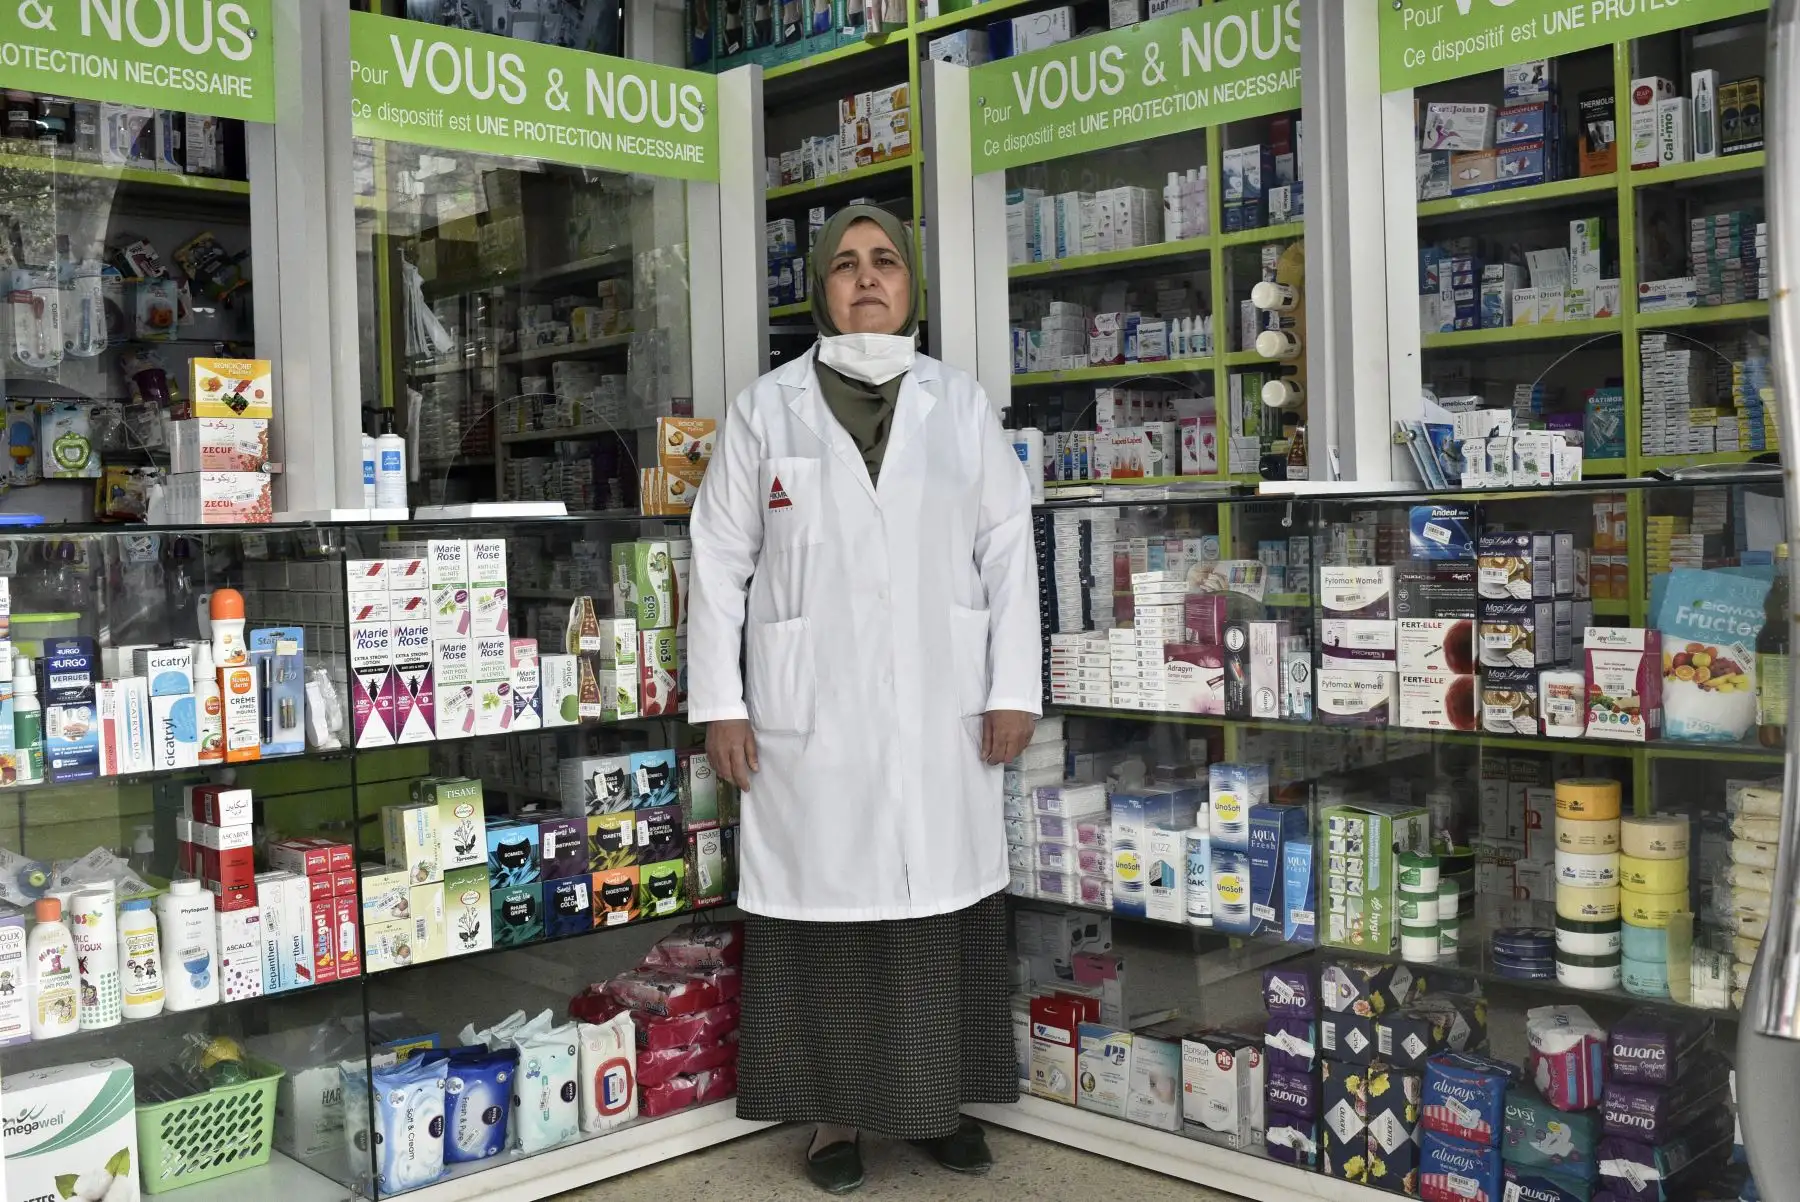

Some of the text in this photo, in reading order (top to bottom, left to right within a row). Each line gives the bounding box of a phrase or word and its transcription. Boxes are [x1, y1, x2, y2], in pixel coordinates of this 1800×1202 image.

[1403, 3, 1442, 31] Pour
[81, 0, 252, 61] NOUS
[1403, 48, 1426, 68] Ce
[1431, 29, 1505, 62] dispositif
[1511, 20, 1537, 41] est
[1543, 3, 1585, 35] UNE
[0, 43, 252, 98] OTECTION NECESSAIRE
[350, 34, 705, 133] Pour VOUS & NOUS
[984, 104, 1012, 126] Pour
[1012, 45, 1126, 115] VOUS
[1141, 42, 1166, 86] &
[984, 139, 1000, 157] Ce
[1004, 124, 1055, 154] dispositif
[1058, 121, 1077, 140] est
[1080, 111, 1109, 135] UNE
[1112, 90, 1210, 130] PROTECTION
[351, 98, 705, 164] Ce dispositif est UNE PROTECTION NECESSAIRE
[436, 544, 461, 553] Marie
[475, 543, 500, 552] Marie
[436, 552, 461, 561] Rose
[476, 551, 500, 560] Rose
[1355, 577, 1382, 585] Women
[644, 595, 656, 620] bio3
[1485, 603, 1503, 614] Magi
[396, 625, 429, 636] Marie
[1401, 621, 1442, 629] FERT-ELLE
[356, 628, 389, 639] Marie
[356, 638, 389, 649] Rose
[397, 635, 429, 646] Rose
[480, 640, 504, 649] Marie
[441, 643, 467, 652] Marie
[480, 648, 504, 657] Rose
[659, 638, 671, 662] bio3
[151, 655, 191, 668] cicatryl
[442, 651, 467, 660] Rose
[57, 658, 87, 668] URGO
[1167, 664, 1193, 673] Adragyn
[52, 674, 89, 682] VERRUES
[517, 669, 535, 677] Marie
[1353, 681, 1382, 690] Women
[1403, 676, 1445, 684] FERT-ELLE
[230, 696, 255, 705] CRÈME
[162, 718, 178, 766] cicatryl
[447, 786, 477, 799] TISANE
[1214, 801, 1241, 813] UnoSoft
[1251, 829, 1276, 842] AQUA
[1251, 840, 1276, 850] Fresh
[1115, 860, 1141, 872] UnoSoft
[1287, 856, 1307, 866] AQUA
[1287, 865, 1307, 873] Fresh
[1216, 882, 1243, 894] UnoSoft
[1371, 911, 1382, 941] hygie
[226, 942, 253, 951] ASCALOL
[1613, 1043, 1666, 1060] awane
[1216, 1051, 1232, 1066] PiC
[1433, 1078, 1476, 1102] always
[1270, 1088, 1308, 1106] awane
[462, 1096, 470, 1117] Fresh
[3, 1112, 65, 1137] megawell
[1605, 1110, 1656, 1130] awane
[407, 1132, 415, 1160] Cream
[1431, 1148, 1475, 1170] always
